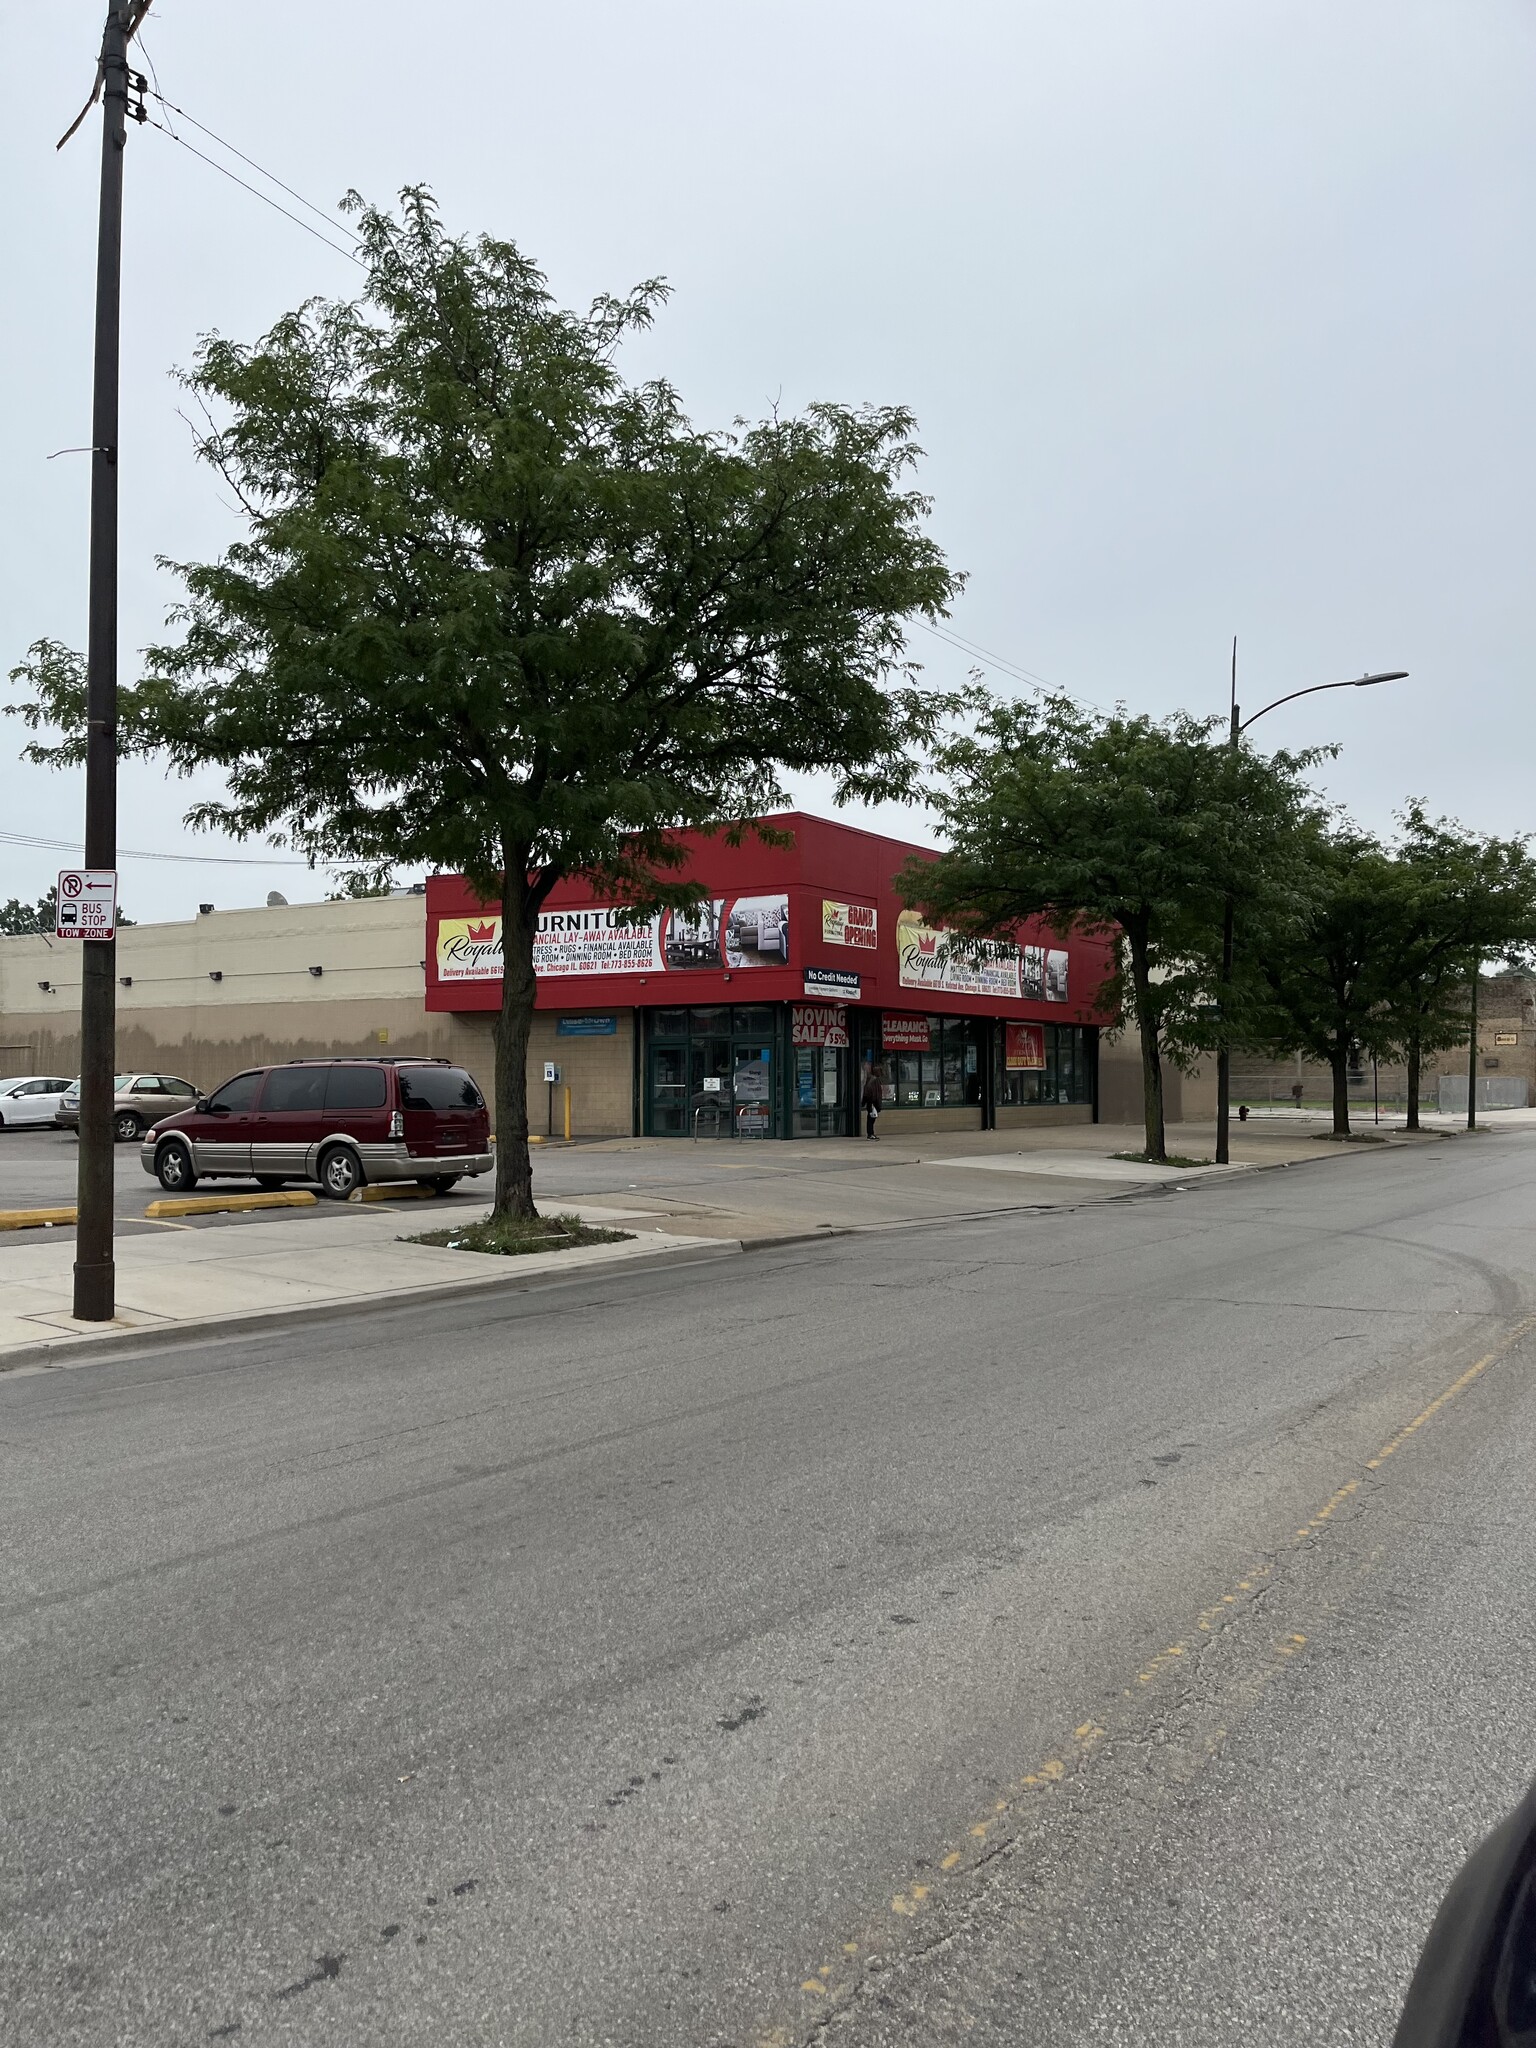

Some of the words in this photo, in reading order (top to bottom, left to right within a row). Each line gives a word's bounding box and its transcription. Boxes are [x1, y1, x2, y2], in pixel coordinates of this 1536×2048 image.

[82, 903, 102, 914] BUS
[81, 915, 107, 926] STOP
[536, 911, 652, 933] URNITU
[848, 905, 874, 928] GRAND
[60, 928, 80, 938] TOW
[84, 928, 109, 938] ZONE
[533, 932, 561, 945] ANCIAL
[563, 929, 606, 944] LAY-AWAY
[607, 926, 653, 941] AVAILABLE
[844, 925, 877, 948] OPENING
[443, 934, 504, 967] Royal
[533, 945, 553, 954] TRESS
[559, 944, 577, 954] RUGS
[583, 941, 617, 952] FINANCIAL
[618, 940, 653, 950] AVAILABLE
[541, 954, 560, 963] ROOM
[593, 951, 612, 960] ROOM
[619, 950, 632, 959] BED
[633, 948, 653, 958] ROOM
[901, 943, 948, 980] Royalty
[546, 963, 570, 973] Chicago
[808, 970, 817, 980] No
[817, 971, 836, 982] Credit
[792, 1007, 846, 1027] MOVING
[792, 1025, 825, 1043] SALE
[883, 1020, 928, 1033] CLEARANCE
[829, 1032, 846, 1045] 35%
